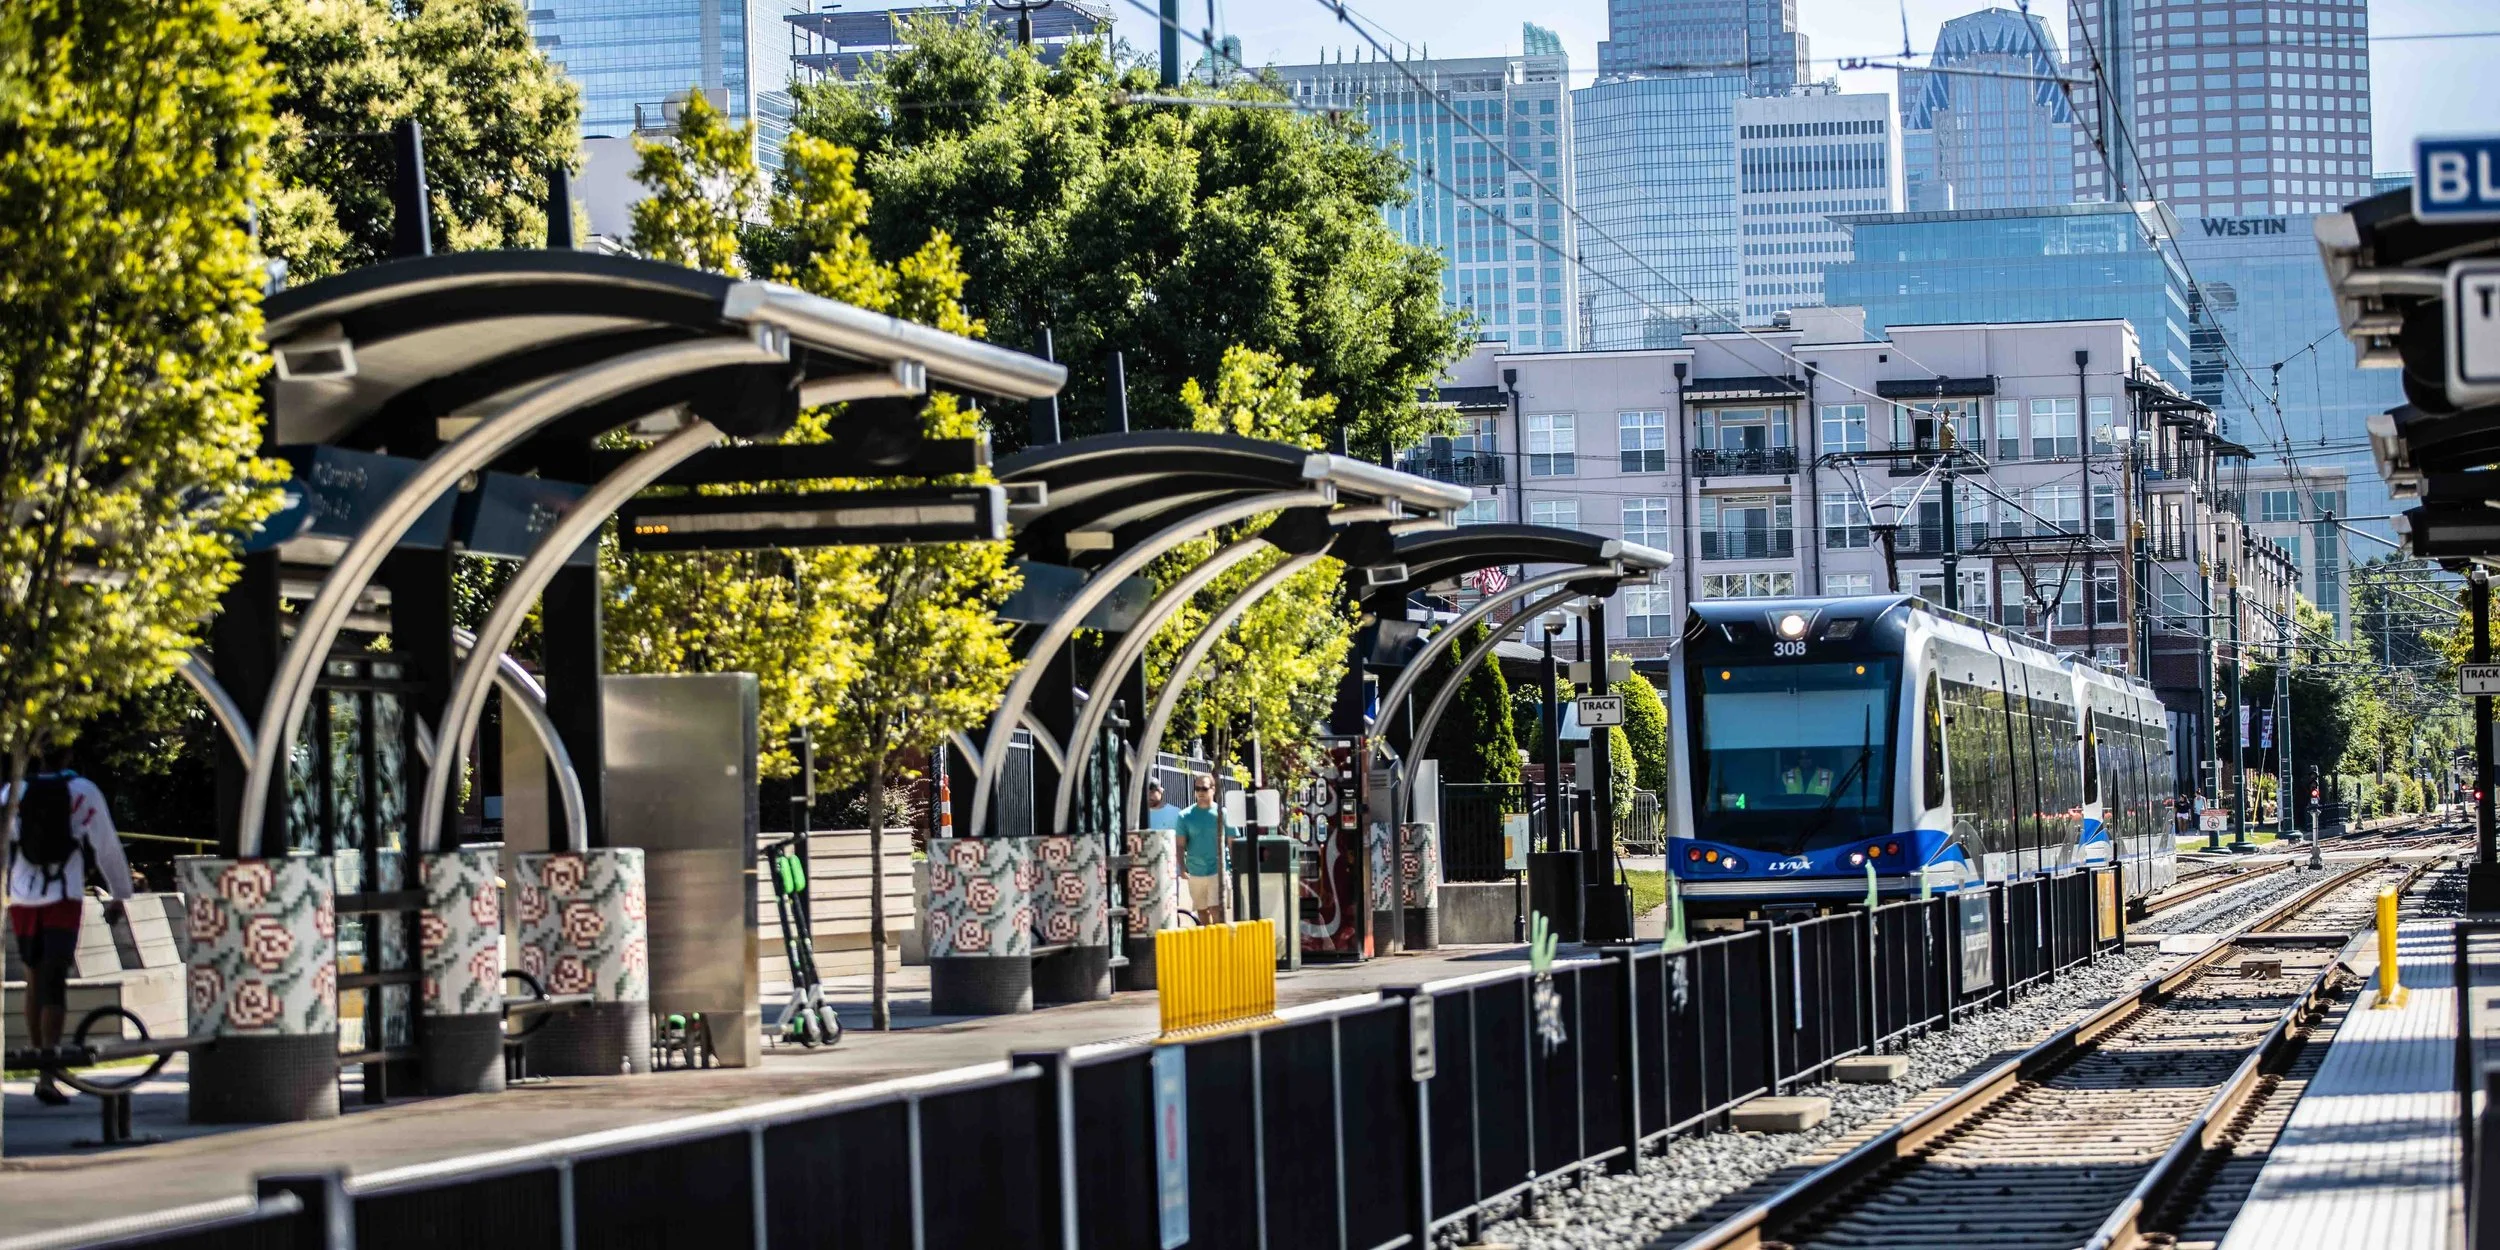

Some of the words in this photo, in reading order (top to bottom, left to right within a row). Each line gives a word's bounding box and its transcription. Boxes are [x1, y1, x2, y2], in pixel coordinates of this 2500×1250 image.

[1773, 641, 1807, 657] 308
[2464, 668, 2500, 679] TRACK
[2479, 680, 2485, 691] 1
[1582, 701, 1616, 710] TRACK
[1596, 712, 1602, 721] 2
[1768, 860, 1814, 871] LYNX
